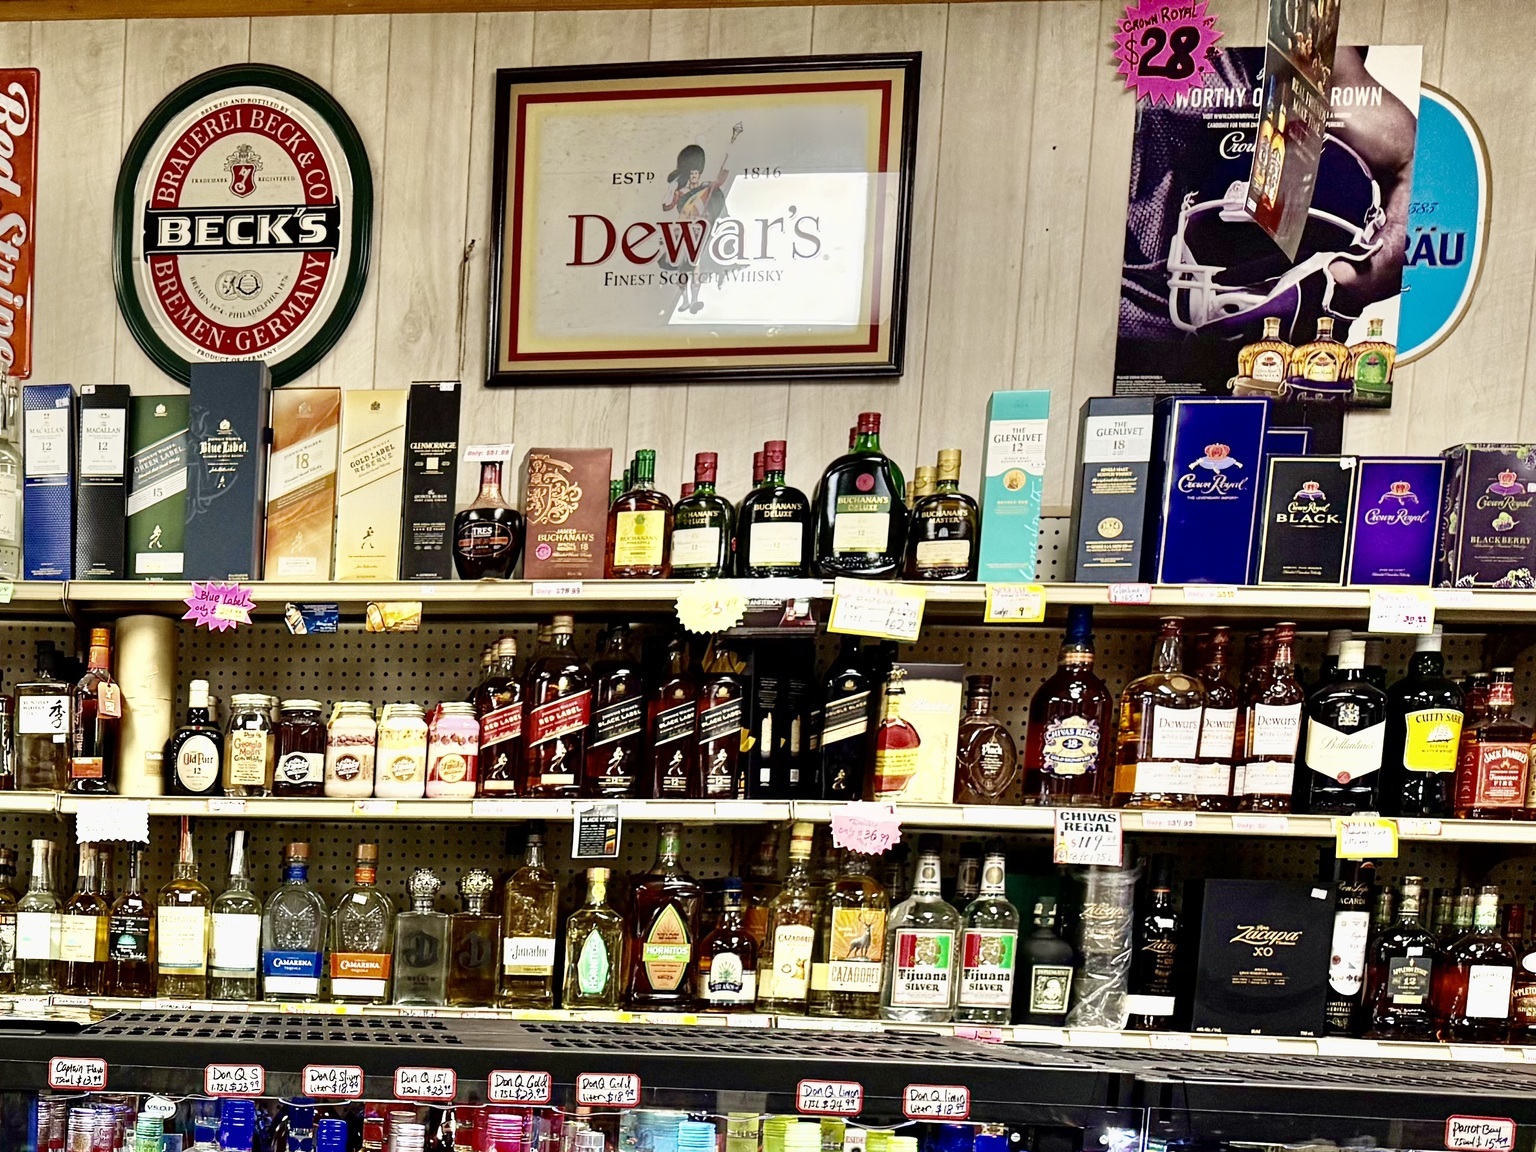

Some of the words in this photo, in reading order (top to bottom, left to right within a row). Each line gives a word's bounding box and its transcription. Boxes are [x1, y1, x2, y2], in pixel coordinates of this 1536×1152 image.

[1123, 16, 1160, 33] CROWN
[1161, 6, 1198, 23] ROYAL
[1176, 87, 1248, 108] WORTHY
[157, 110, 242, 203] BRAUEREI
[249, 108, 303, 148] BECK
[743, 166, 782, 180] 1846
[158, 208, 327, 246] BECK'S
[567, 205, 823, 266] Dewar's
[604, 271, 655, 287] FINEST
[659, 270, 719, 285] SCOTCH
[721, 267, 784, 285] WHISKY
[155, 260, 226, 346] BREMEN
[235, 253, 326, 351] GERMANY
[29, 426, 64, 435] MACALLAN
[85, 426, 120, 435] MACALLAN
[1097, 427, 1144, 437] GLENLIVET
[994, 434, 1043, 443] GLENLIVET
[134, 457, 163, 473] GREEN
[294, 454, 310, 469] 18
[152, 487, 163, 498] 15
[754, 503, 803, 511] BUCHANAN'S
[538, 534, 594, 542] BUCHANAN'S
[1470, 536, 1531, 545] BLACKBERRY
[1159, 718, 1197, 730] Dewar's
[1321, 735, 1374, 751] Ballantine's
[1060, 812, 1116, 822] CHIVAS
[1065, 822, 1113, 833] REGAL
[646, 946, 688, 957] HORNITOS
[1253, 946, 1273, 956] XO
[273, 959, 312, 969] CAMARENA
[340, 959, 381, 969] CAMARENA
[831, 966, 879, 981] CAZADORES
[898, 969, 946, 981] Tijuana
[964, 969, 1010, 981] Tijuana
[905, 983, 939, 992] SILVER
[968, 983, 1005, 992] SILVER
